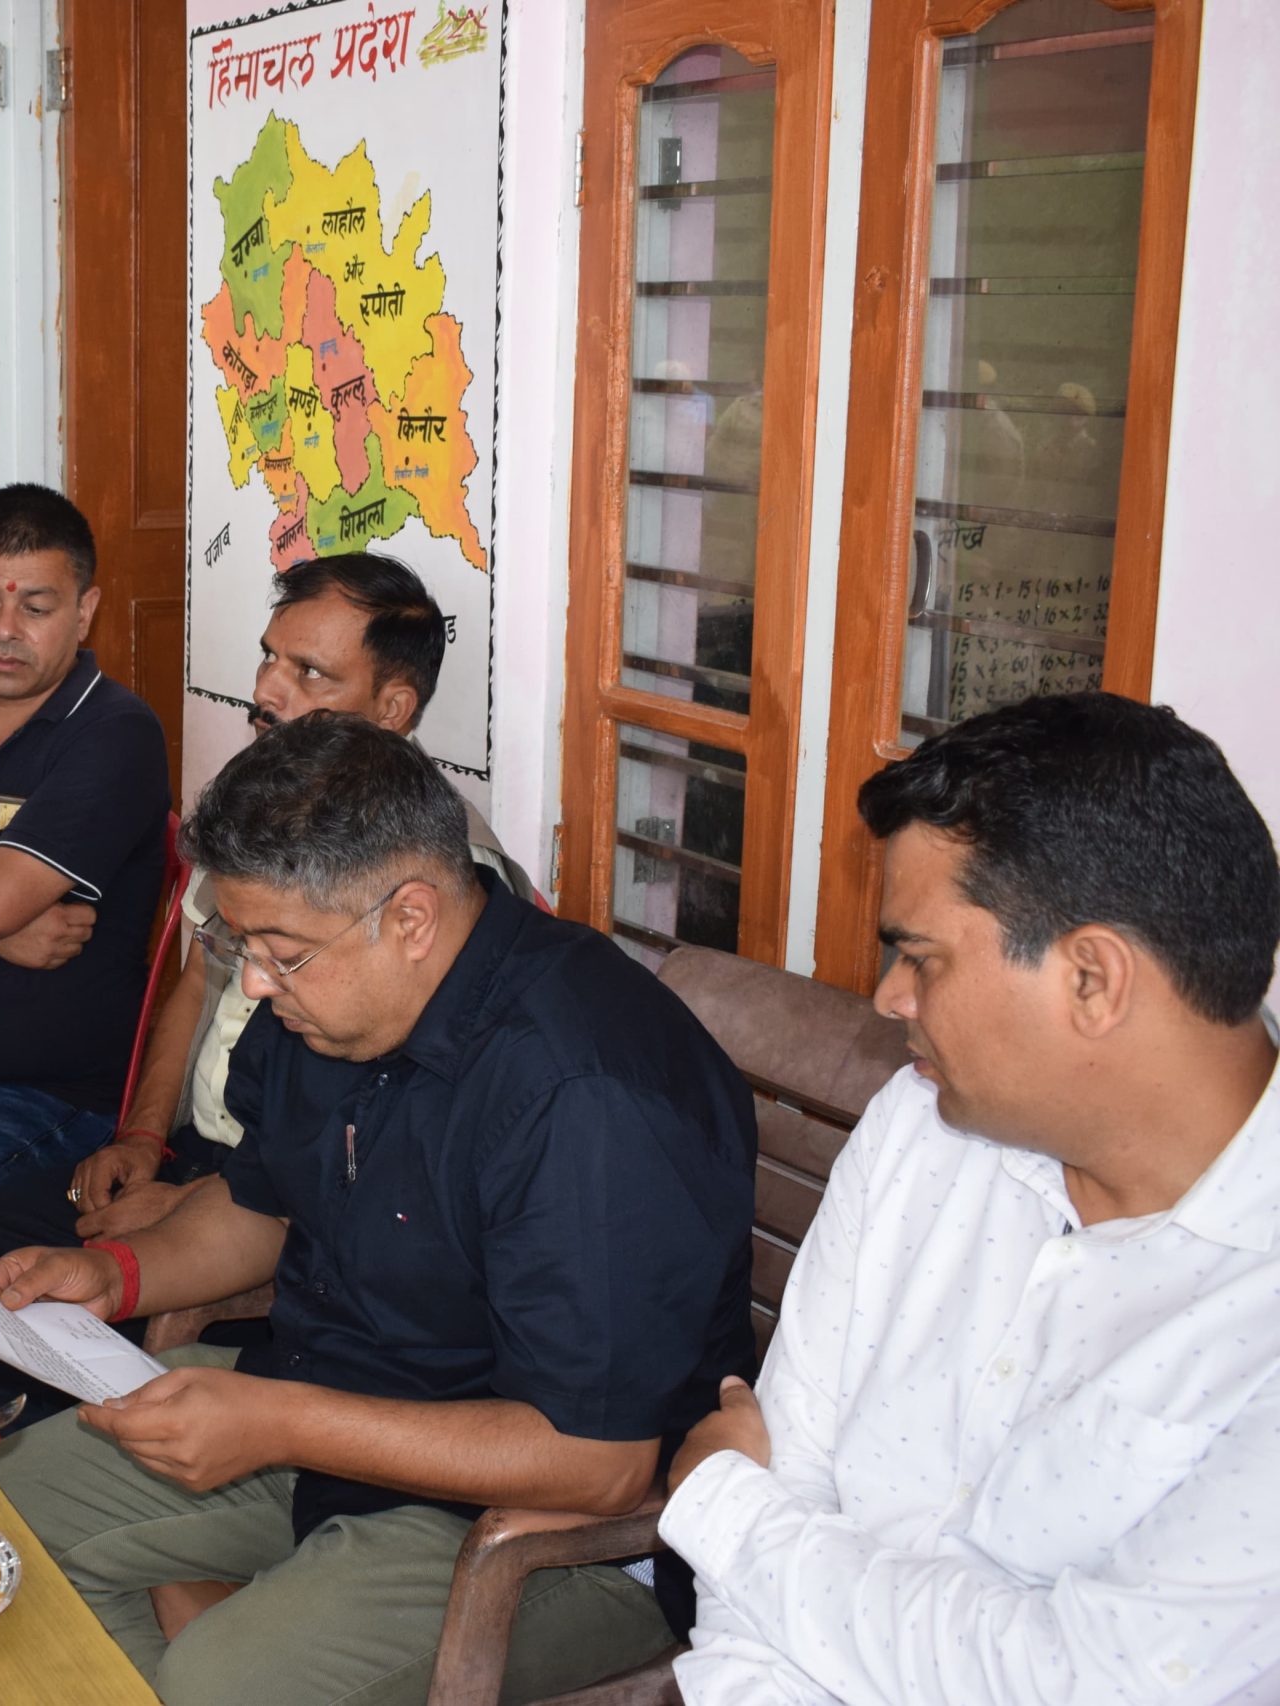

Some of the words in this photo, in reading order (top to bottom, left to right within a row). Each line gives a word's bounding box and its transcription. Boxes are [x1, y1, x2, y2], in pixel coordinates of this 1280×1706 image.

[207, 33, 321, 110] हिमाचल
[330, 2, 416, 82] प्रदेश
[322, 197, 366, 239] लाहौल
[343, 254, 365, 285] और
[360, 282, 406, 327] स्पीती
[397, 406, 447, 443] किन्नौर
[339, 497, 387, 541] शिमला
